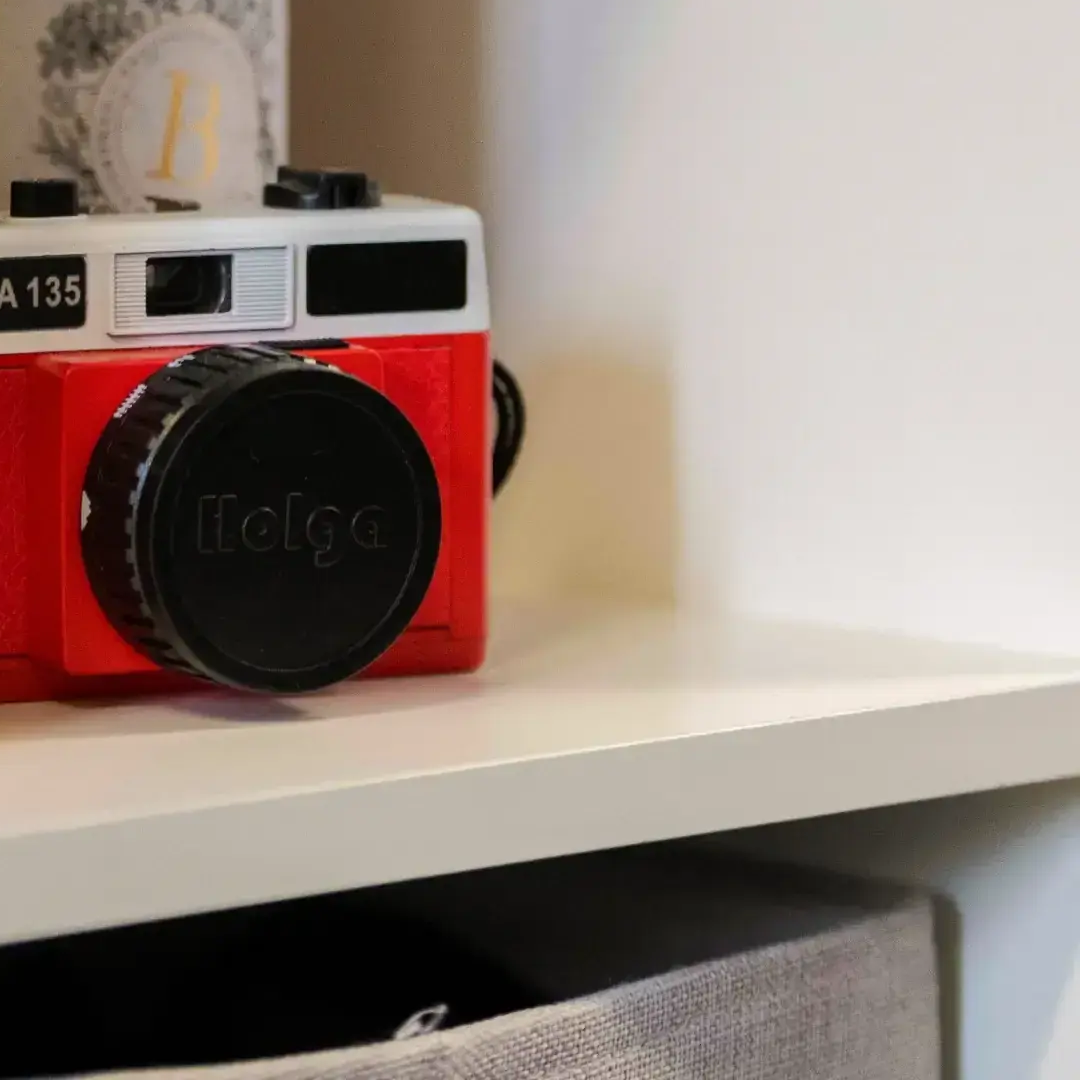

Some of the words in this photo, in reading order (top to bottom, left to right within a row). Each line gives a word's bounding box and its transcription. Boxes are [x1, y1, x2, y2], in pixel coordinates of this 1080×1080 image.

[146, 68, 221, 189] B
[26, 274, 82, 308] 135
[197, 491, 388, 568] Holga
